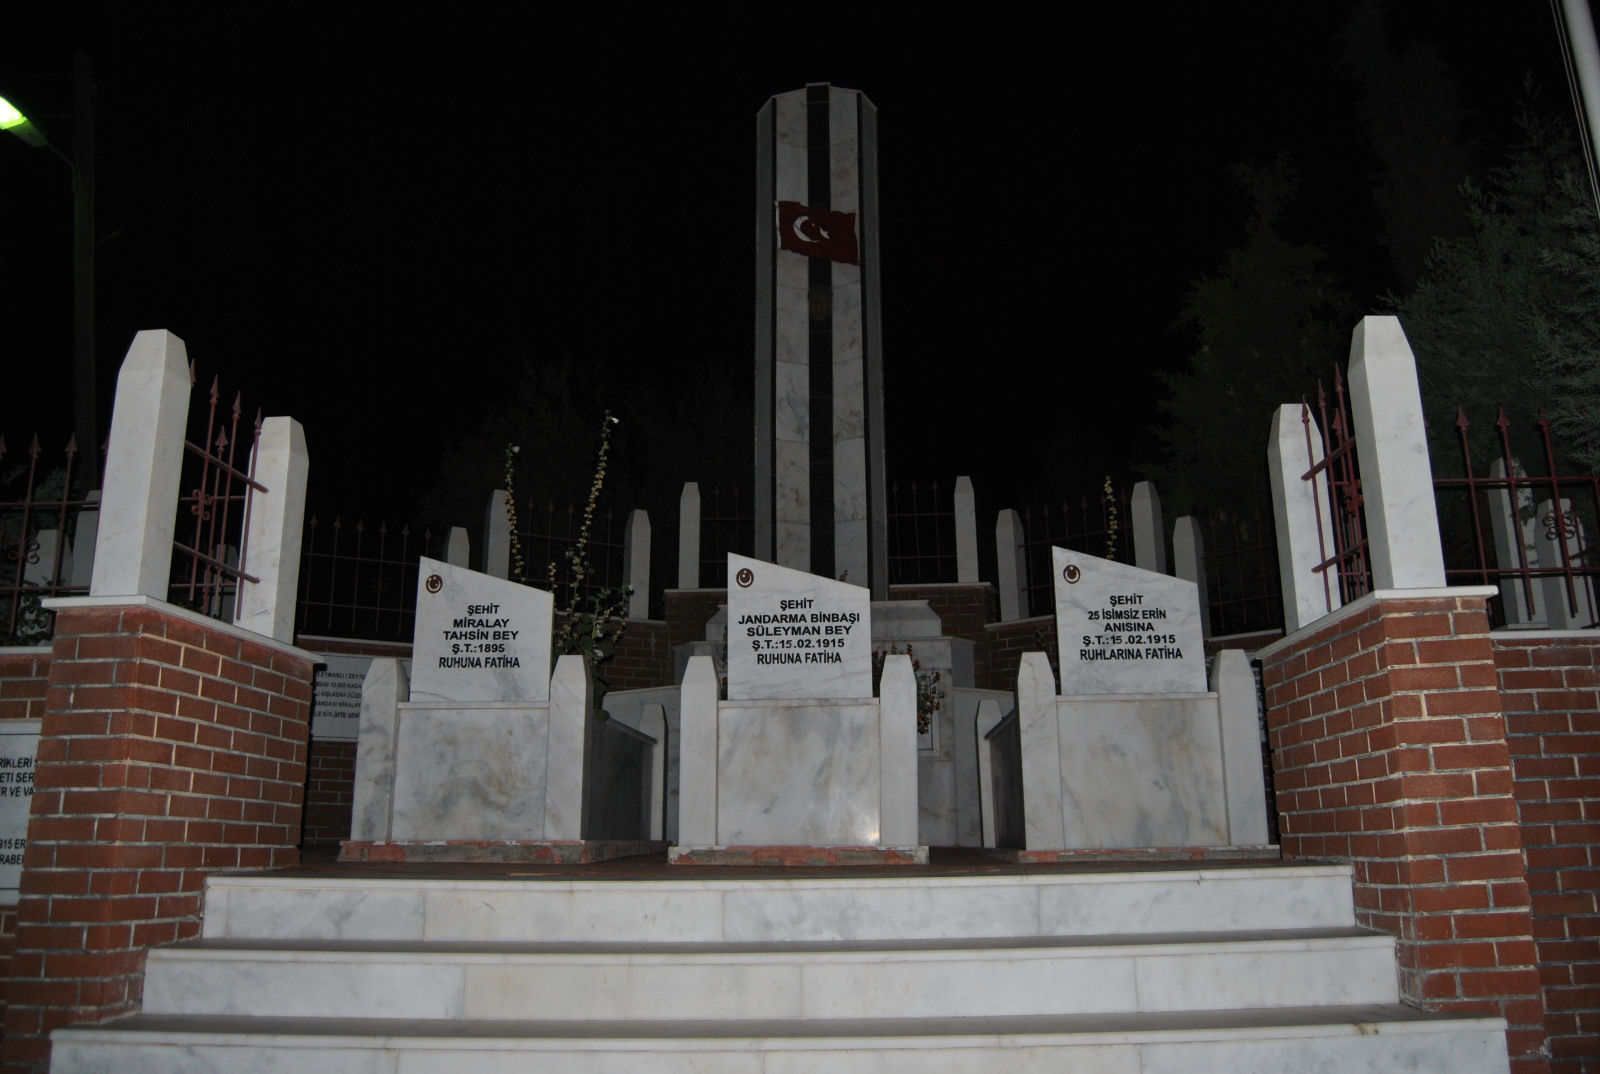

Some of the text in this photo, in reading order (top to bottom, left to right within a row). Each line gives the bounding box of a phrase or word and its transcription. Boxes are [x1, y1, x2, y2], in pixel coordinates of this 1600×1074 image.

[780, 598, 814, 611] ŞEHİT
[1110, 593, 1143, 607] ŞEHİT
[467, 603, 500, 616] ŞEHİT
[1088, 608, 1166, 620] 25 İSİMSİZ ERİN
[453, 617, 509, 628] MİRALAY
[738, 611, 860, 625] JANDARMA BİNBAŞI
[747, 625, 852, 636] SÜLEYMAN BEY
[1104, 622, 1154, 632] ANISINA
[443, 629, 519, 640] TAHSİN BEY
[452, 644, 505, 655] Ş.T.:1895
[752, 639, 844, 651] Ş.T.:15.02.1915
[757, 650, 841, 665] RUHUNA FATİHA
[1080, 645, 1183, 660] RUHLARINA FATİHA
[439, 655, 520, 668] RUHUNA FATİHA
[10, 786, 21, 797] VE
